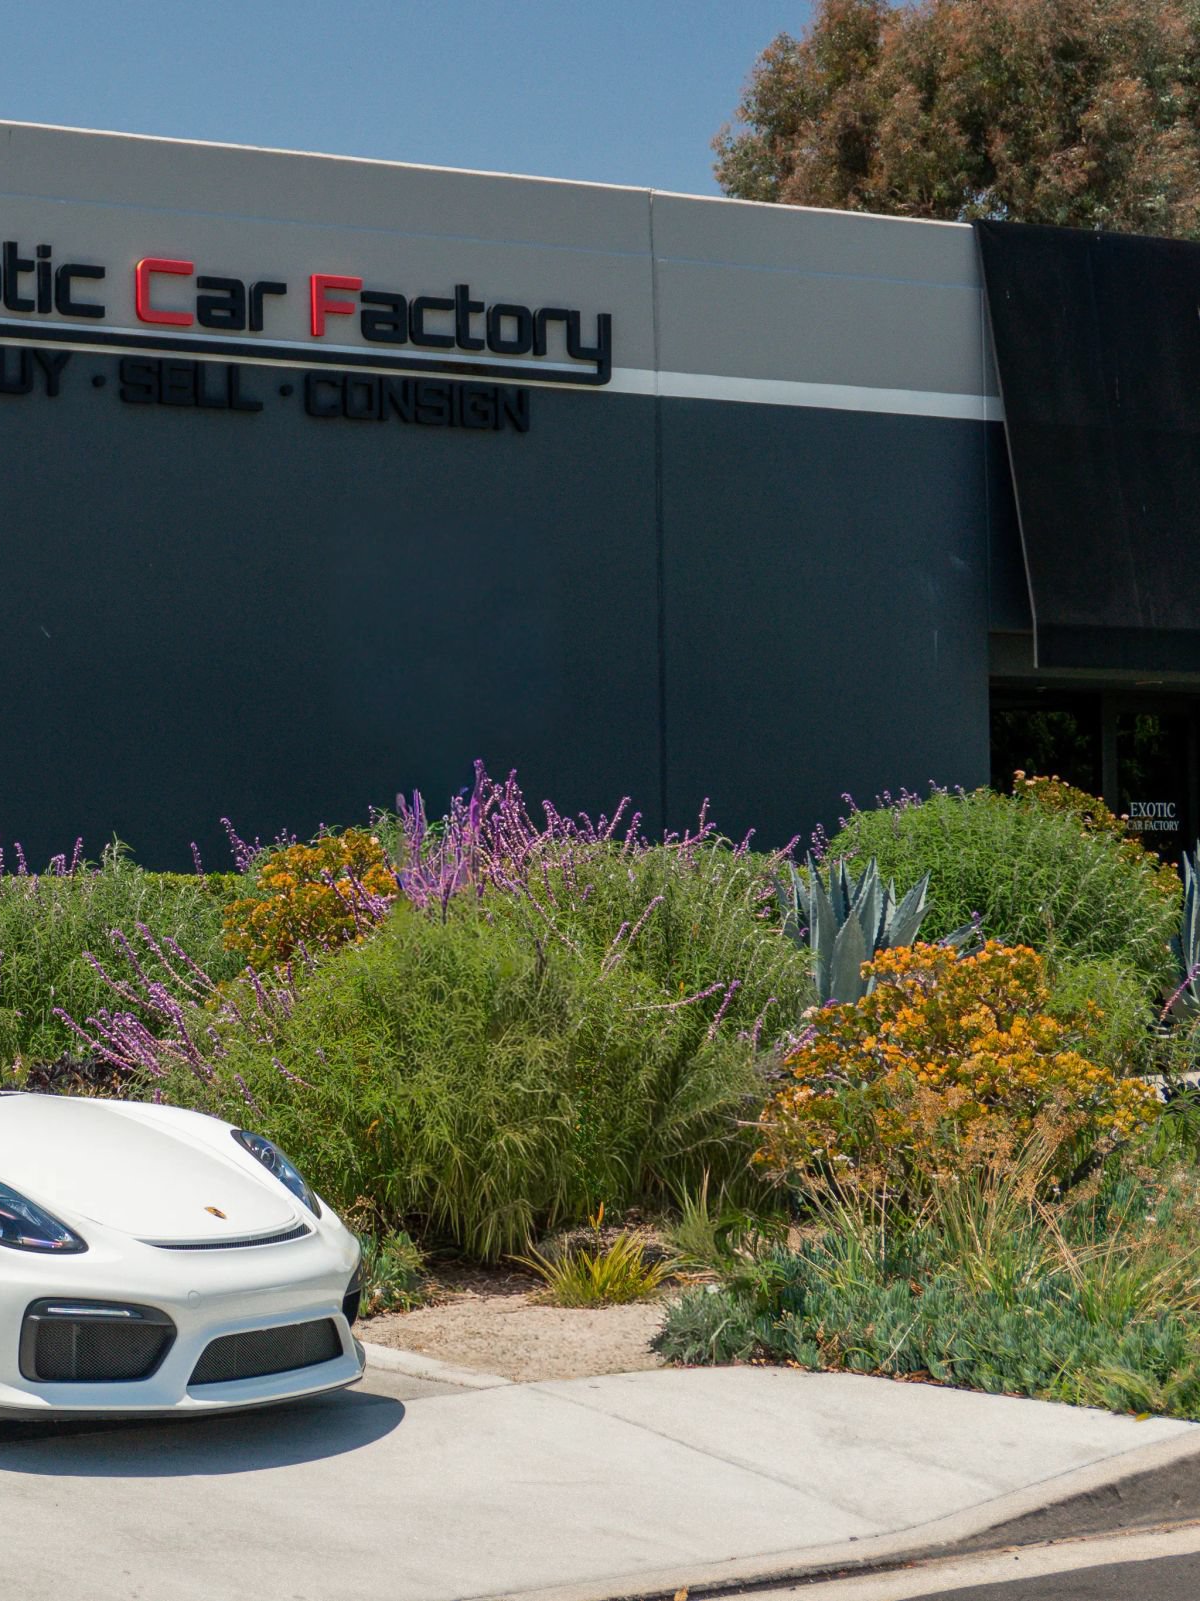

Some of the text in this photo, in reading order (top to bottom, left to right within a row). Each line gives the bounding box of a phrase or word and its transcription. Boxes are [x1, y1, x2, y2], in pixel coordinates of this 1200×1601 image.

[135, 257, 288, 332] Car
[310, 274, 612, 385] Factory
[118, 357, 263, 412] SELL
[304, 371, 531, 433] CONSIGN
[1127, 820, 1180, 831] CAR FACTORY
[1130, 802, 1176, 818] EXOTIC
